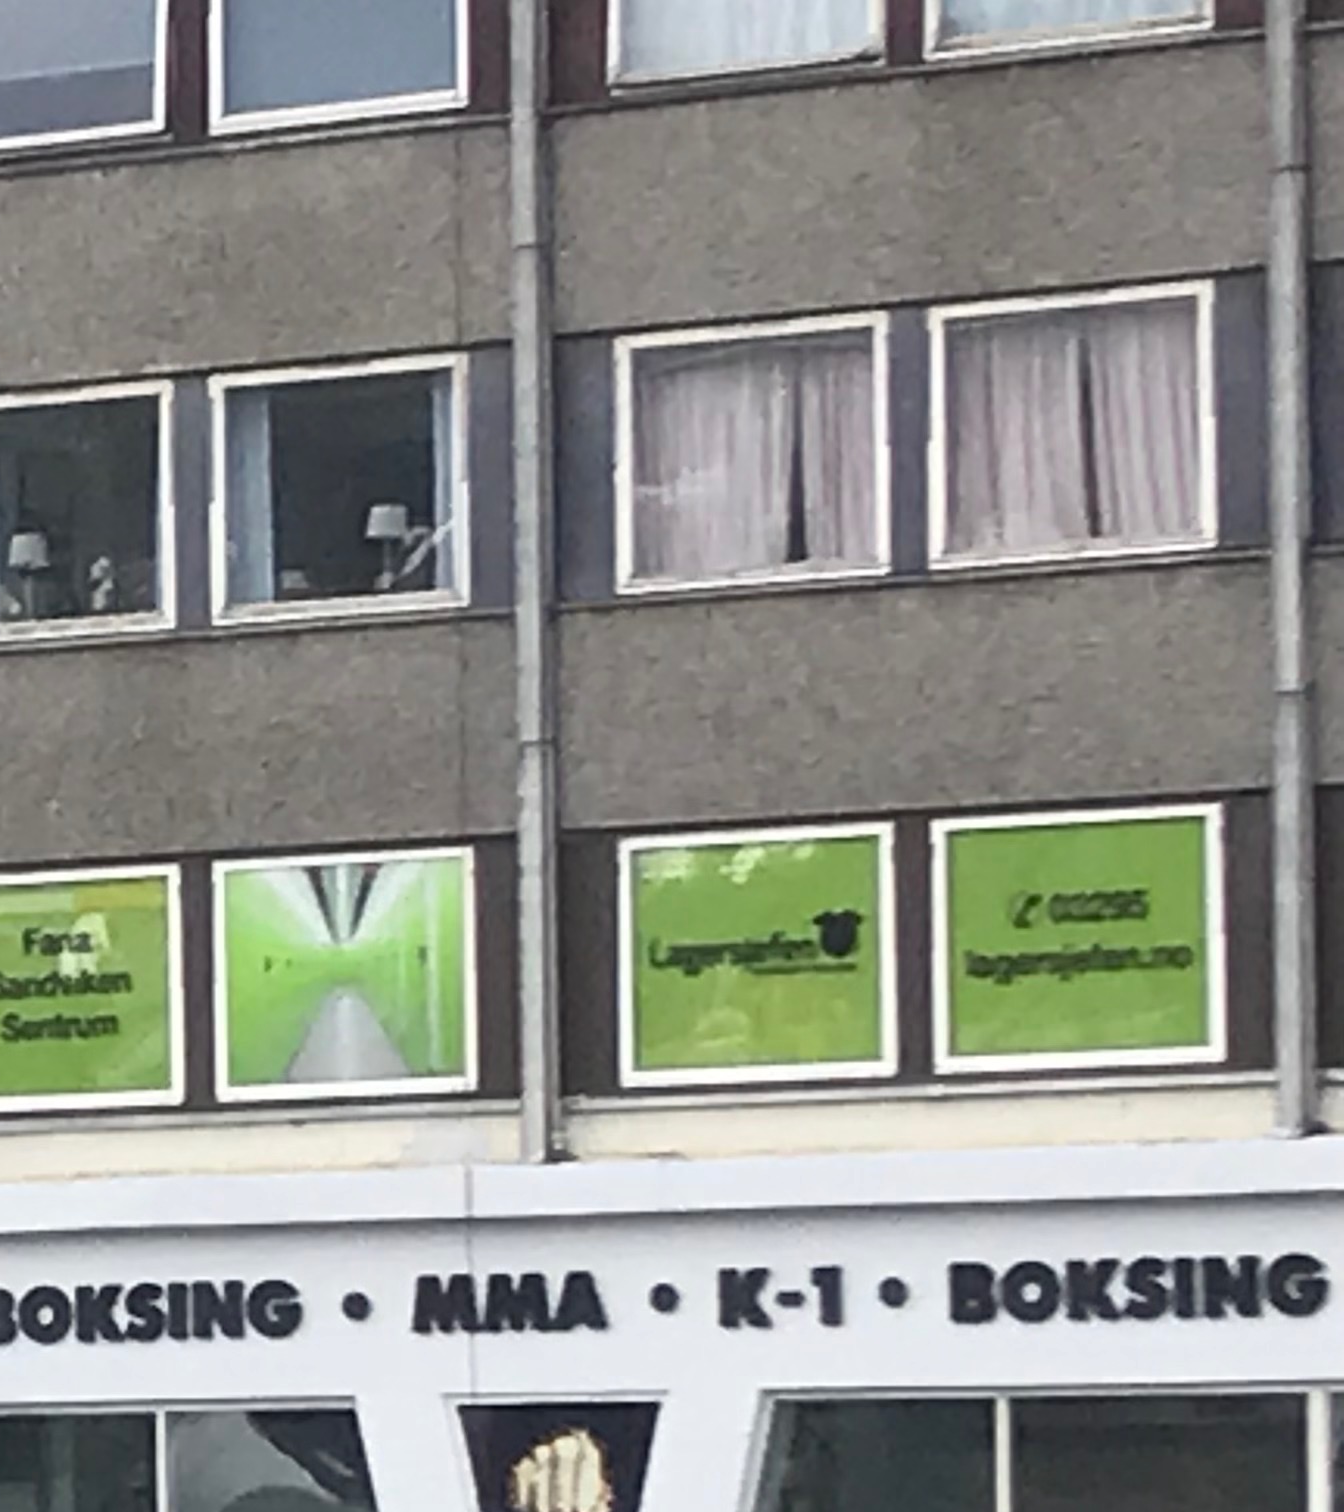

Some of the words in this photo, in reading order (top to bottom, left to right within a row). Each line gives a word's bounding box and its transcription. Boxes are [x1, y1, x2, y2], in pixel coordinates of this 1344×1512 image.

[22, 927, 93, 955] Fana
[0, 1012, 119, 1041] Sentrum
[412, 1271, 607, 1334] MMA
[718, 1266, 843, 1328] K-1
[948, 1254, 1329, 1324] BOKSING
